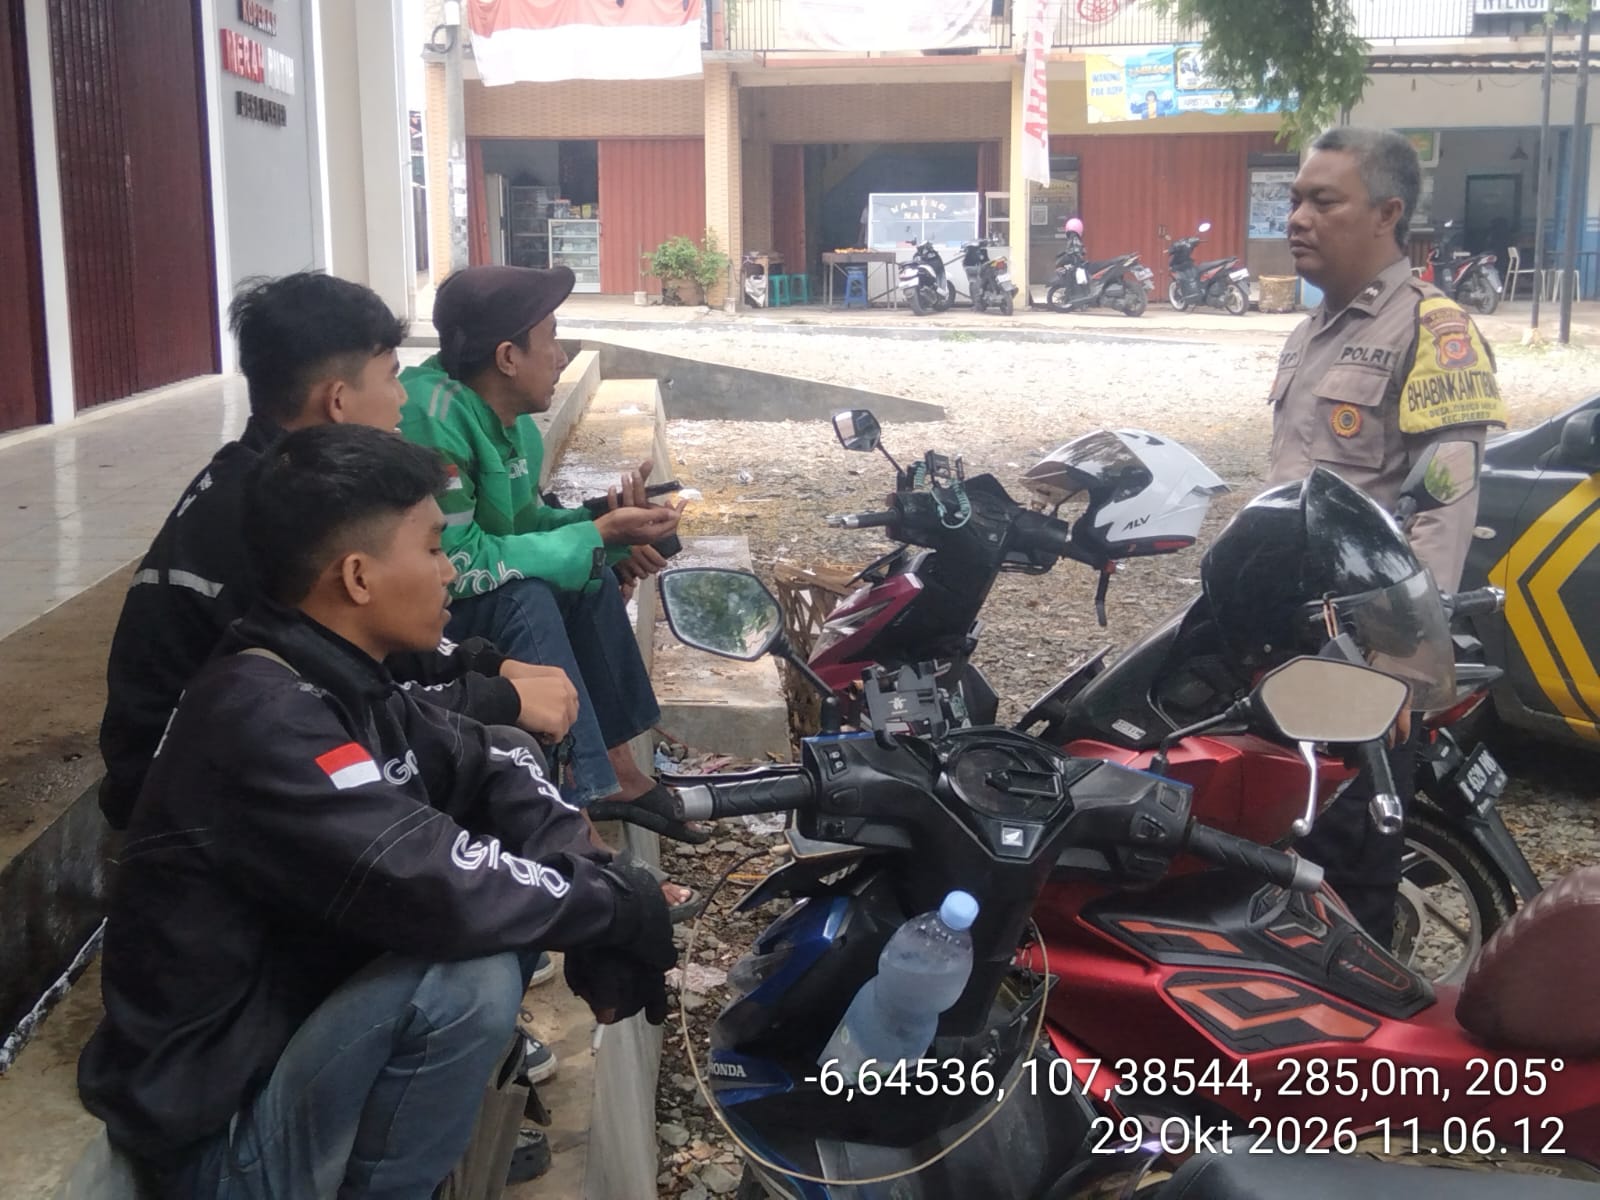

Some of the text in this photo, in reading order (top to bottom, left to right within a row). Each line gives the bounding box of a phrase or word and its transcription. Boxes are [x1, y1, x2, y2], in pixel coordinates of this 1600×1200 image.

[219, 28, 264, 84] MERAH
[1340, 346, 1392, 365] POLRI
[1121, 514, 1151, 532] ALV
[383, 749, 419, 785] Gr
